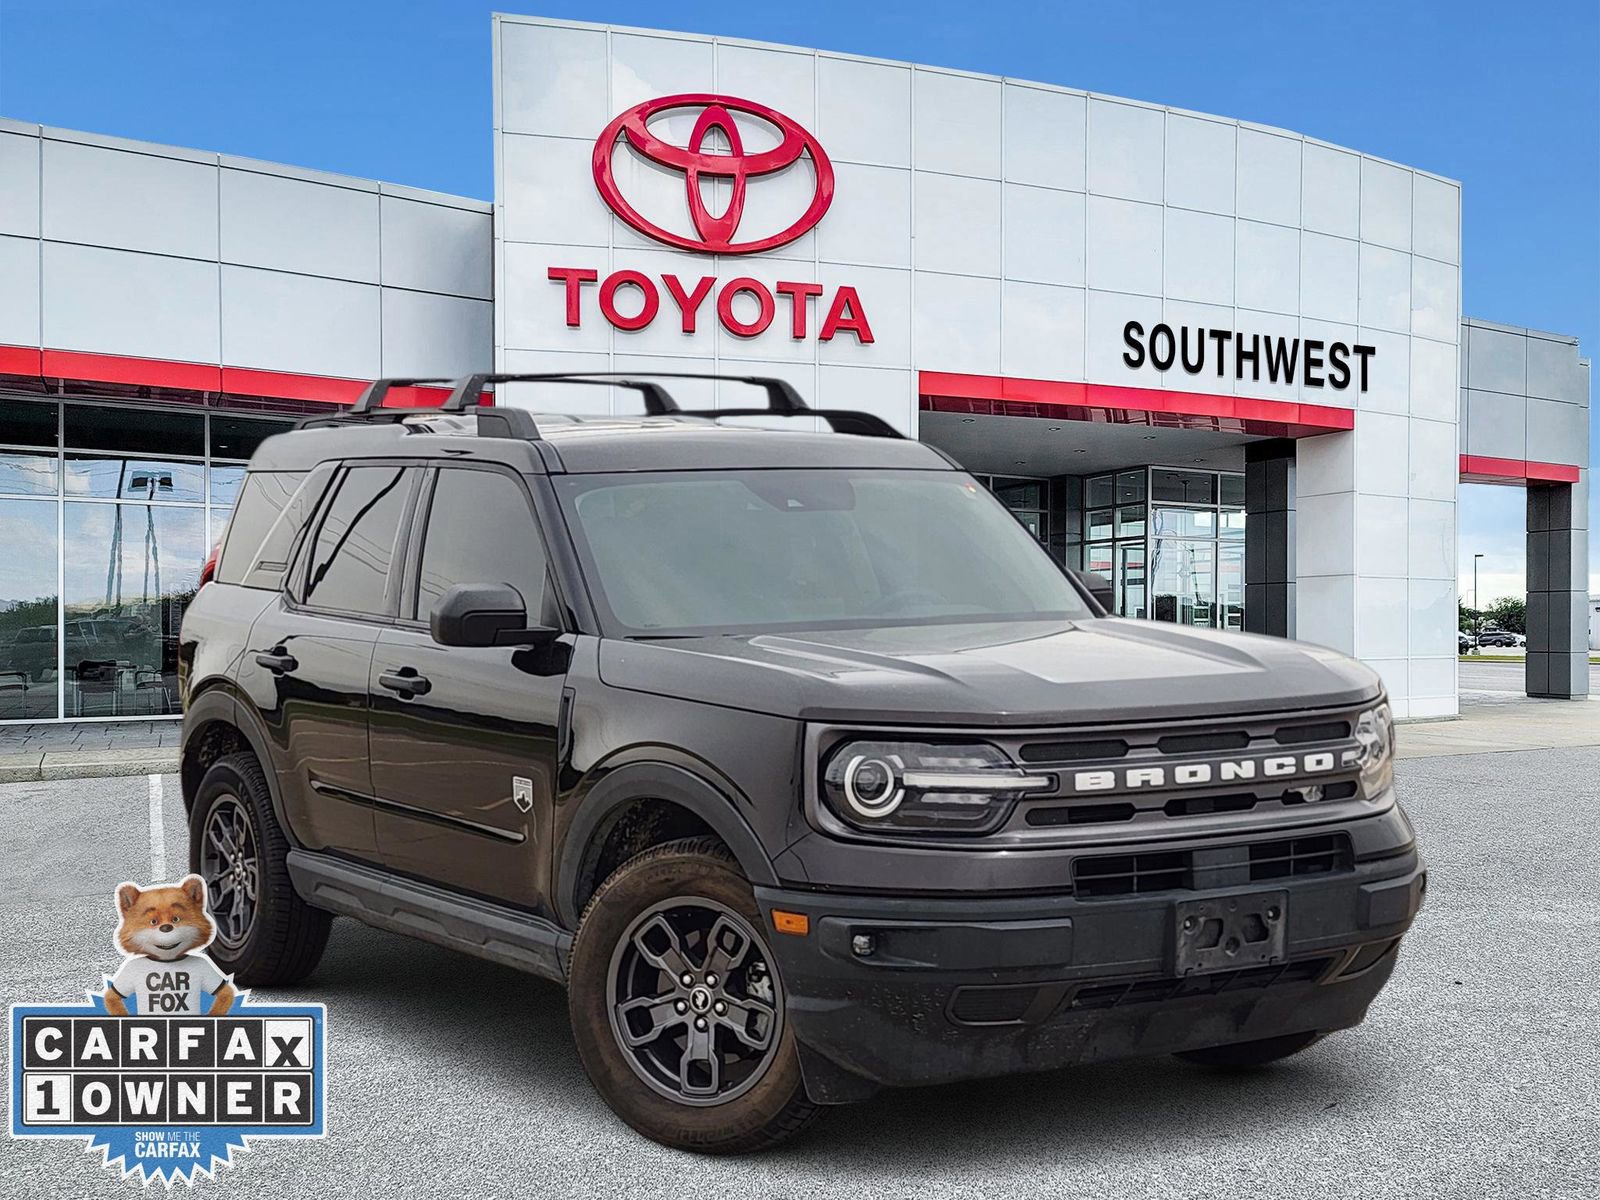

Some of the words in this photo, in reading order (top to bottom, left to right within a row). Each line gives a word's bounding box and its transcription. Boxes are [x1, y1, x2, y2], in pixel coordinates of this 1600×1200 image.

[548, 266, 875, 344] TOYOTA
[1123, 320, 1376, 393] SOUTHWEST
[1074, 752, 1334, 791] BRONCO
